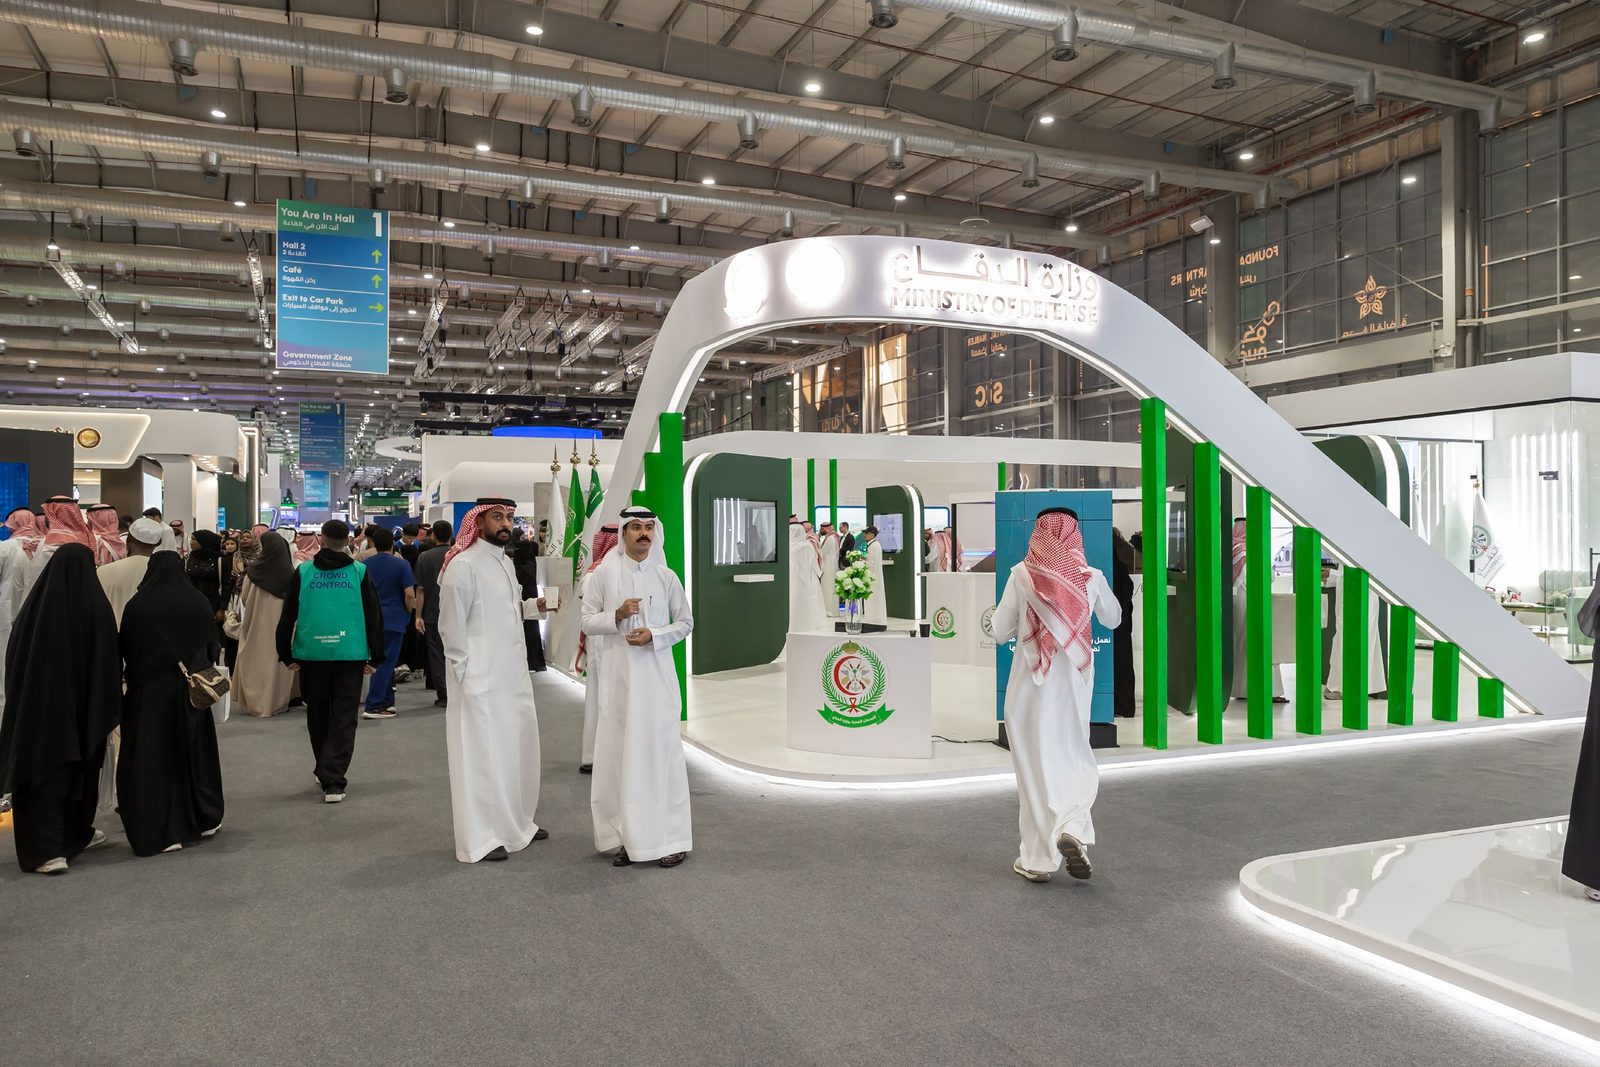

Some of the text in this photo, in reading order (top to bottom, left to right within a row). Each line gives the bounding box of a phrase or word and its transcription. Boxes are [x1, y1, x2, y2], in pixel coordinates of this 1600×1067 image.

[281, 208, 355, 224] You Are In Hall
[283, 219, 303, 227] القاعة
[304, 223, 314, 231] في
[372, 212, 383, 237] 1
[282, 241, 298, 249] Hall
[282, 265, 302, 274] Café
[893, 245, 1098, 302] وزارة الدفاع
[282, 294, 298, 302] Exit
[309, 296, 324, 304] Car
[325, 297, 344, 305] Park
[891, 287, 989, 313] MINISTRY
[992, 296, 1017, 316] OF
[282, 350, 353, 361] Government Zone
[314, 572, 348, 580] CROWD
[310, 581, 353, 589] CONTROL
